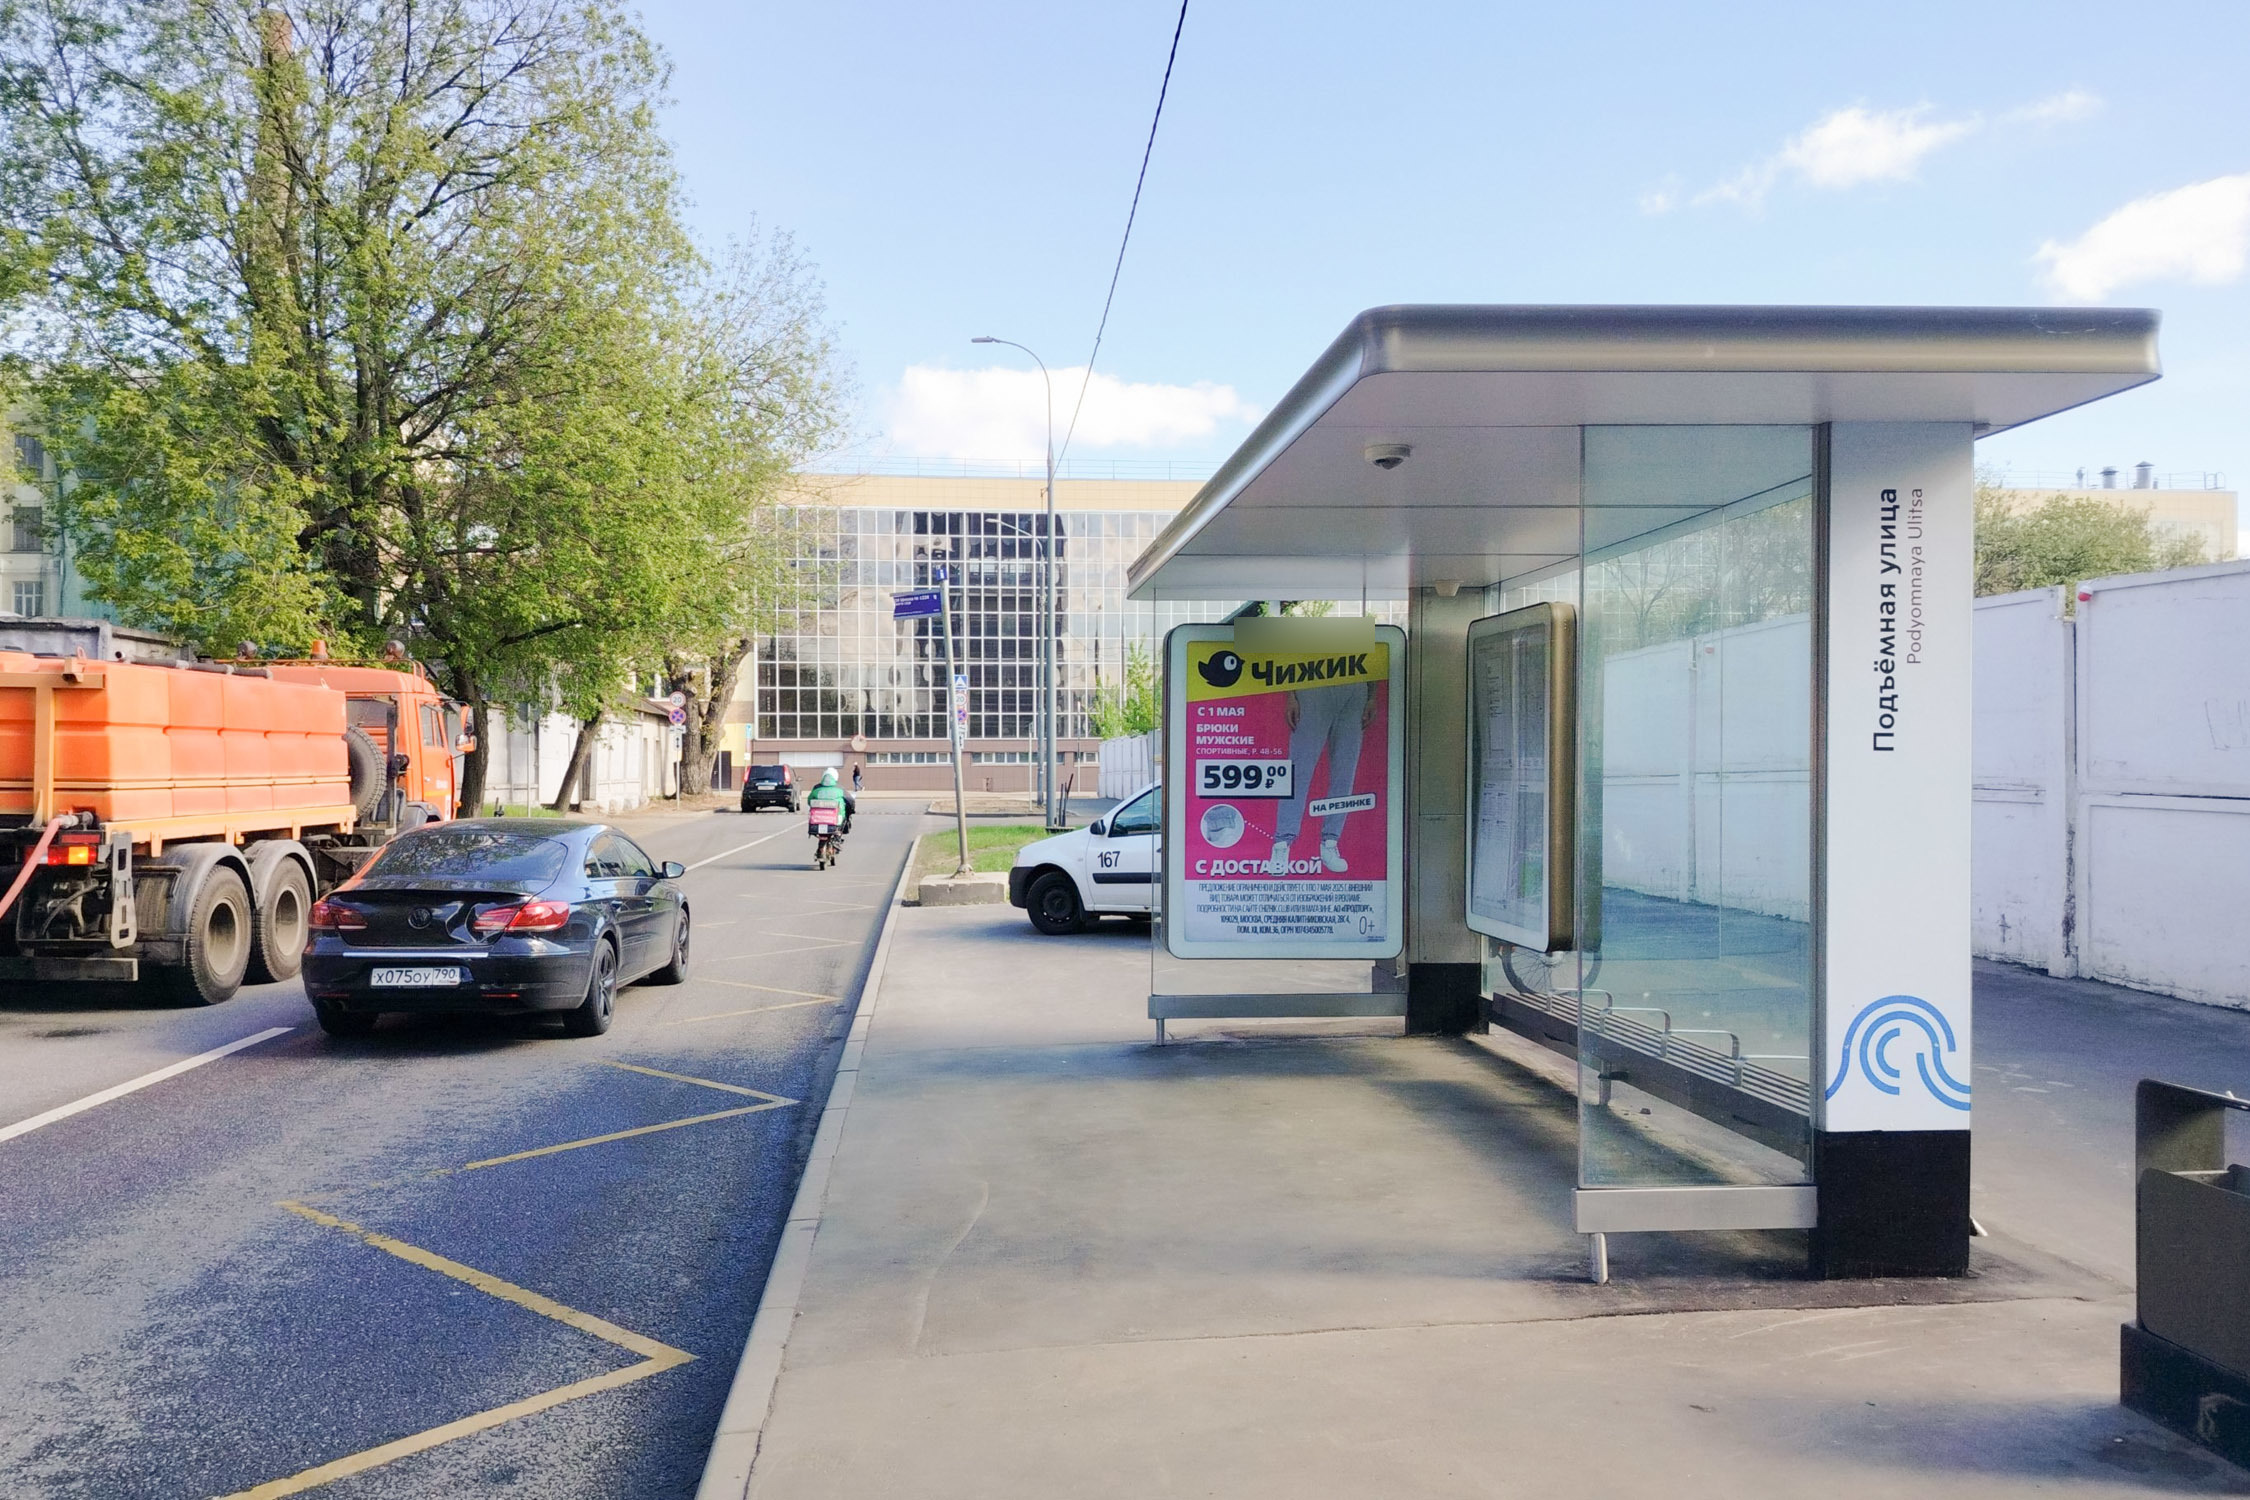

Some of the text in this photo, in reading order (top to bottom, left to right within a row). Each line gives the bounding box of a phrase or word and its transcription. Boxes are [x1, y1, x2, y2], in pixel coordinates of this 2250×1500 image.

[1906, 488, 1926, 664] Podyomnaya Ulitsa
[1873, 488, 1901, 751] Подъёмная улица
[1197, 706, 1245, 716] С 1 МАЯ
[1196, 723, 1239, 733] БРЮКИ
[1196, 736, 1255, 745] МУЖСКИЕ
[1196, 748, 1251, 756] СПОРТИВНЫЕ,
[1203, 765, 1263, 790] 599
[1266, 766, 1287, 777] 00
[1312, 797, 1372, 813] НА РЕЗИНКЕ
[1097, 850, 1121, 868] 167
[1195, 856, 1323, 877] С ДОСТАВКОЙ
[1359, 915, 1375, 935] 0+
[433, 968, 456, 979] 790
